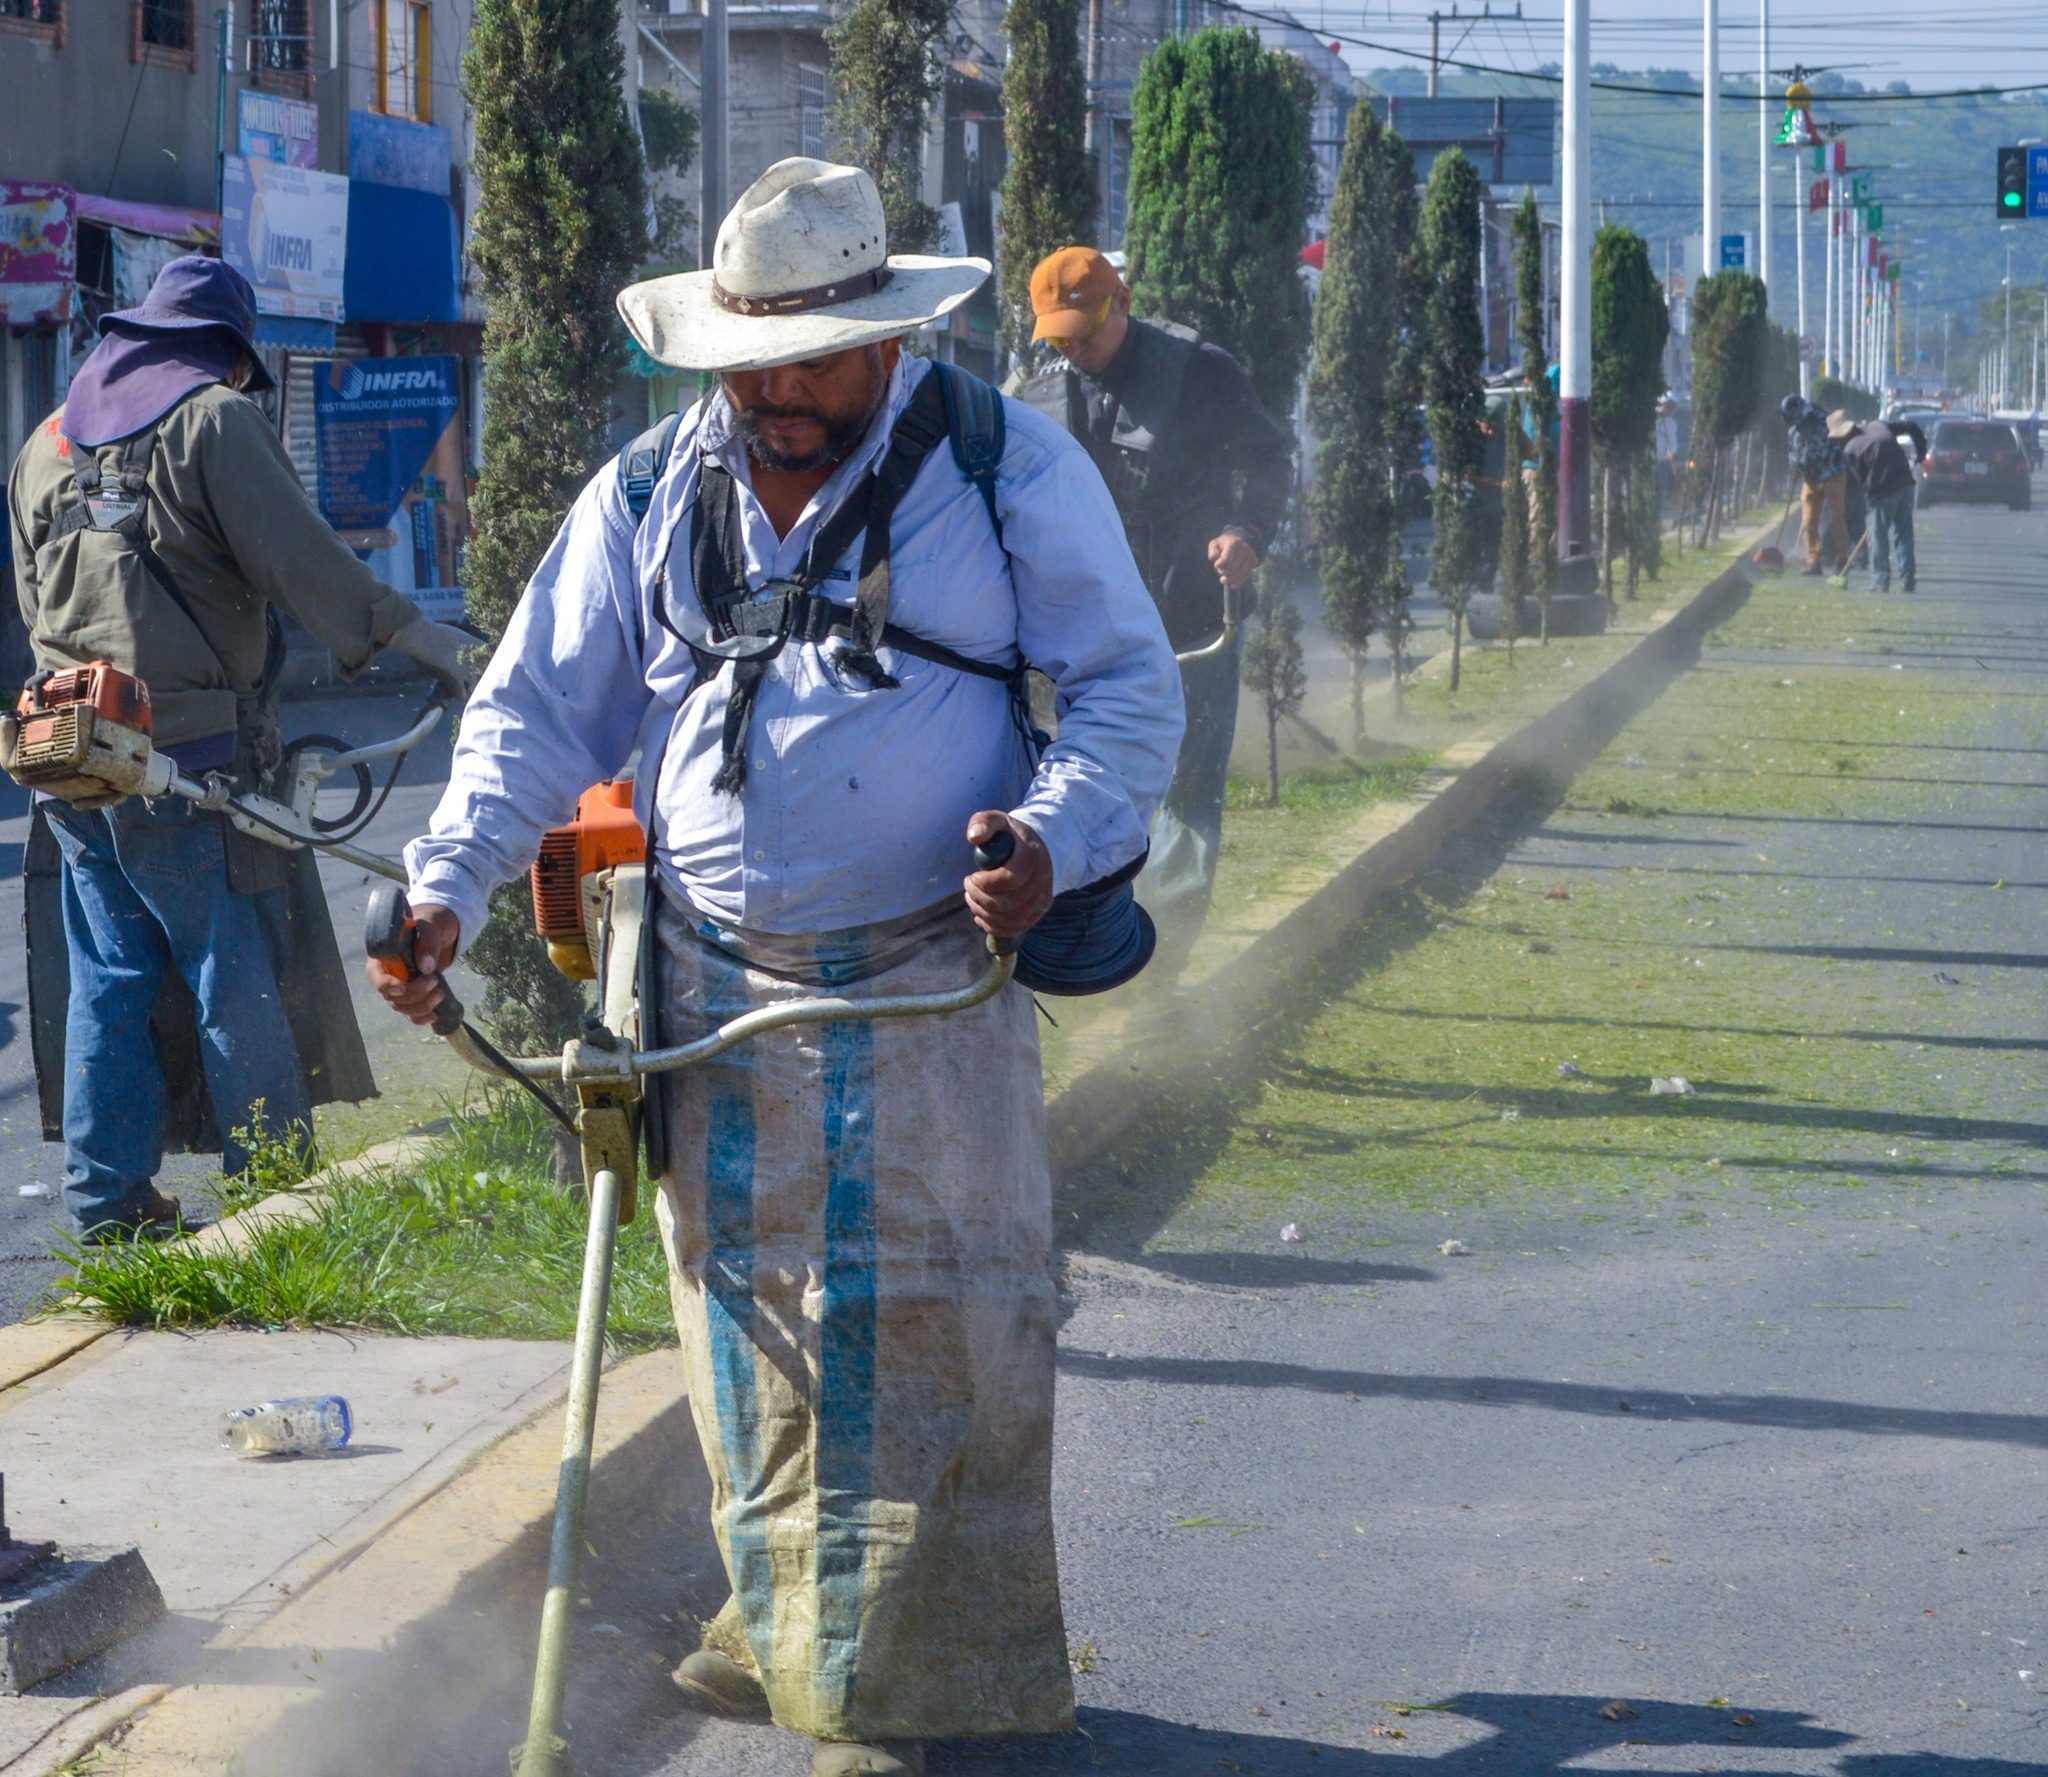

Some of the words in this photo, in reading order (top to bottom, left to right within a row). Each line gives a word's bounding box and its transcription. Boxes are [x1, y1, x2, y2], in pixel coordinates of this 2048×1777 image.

[270, 232, 313, 271] INFRA
[364, 370, 438, 391] INFRA
[319, 400, 389, 412] DISTRIBUIDOR
[391, 396, 457, 408] AUTORIZADO
